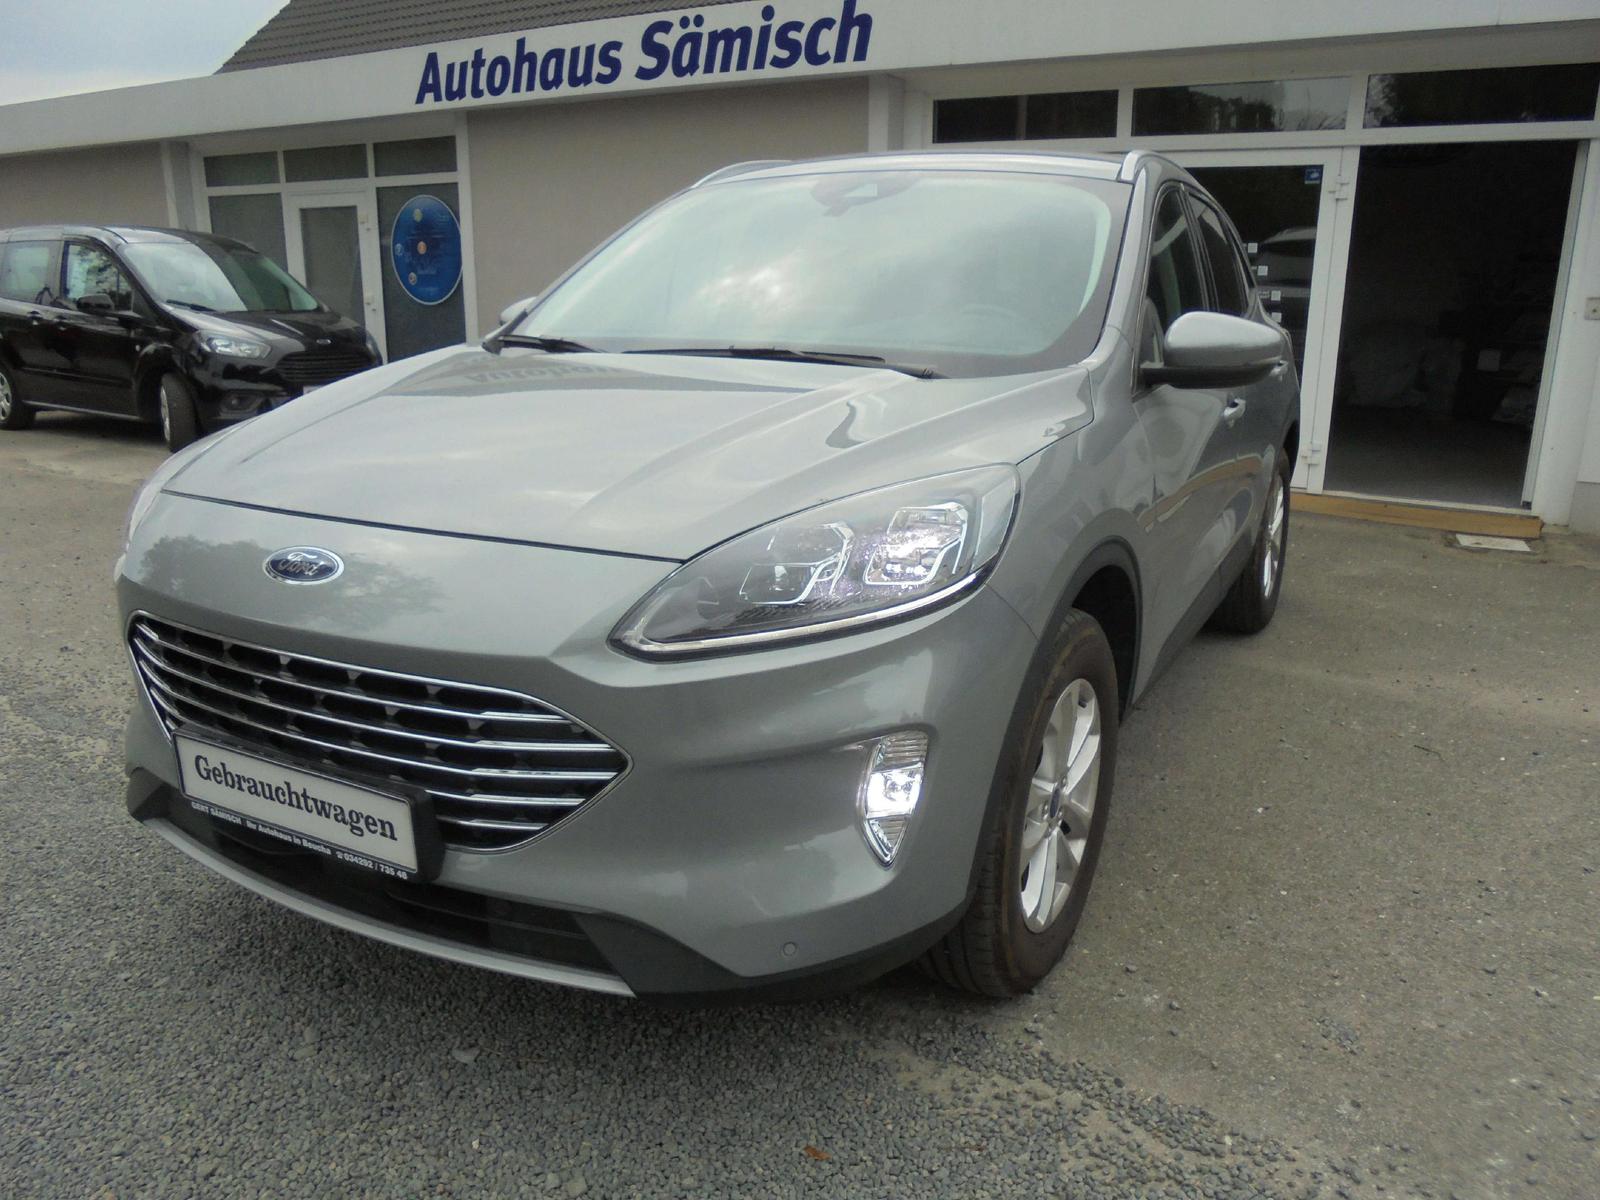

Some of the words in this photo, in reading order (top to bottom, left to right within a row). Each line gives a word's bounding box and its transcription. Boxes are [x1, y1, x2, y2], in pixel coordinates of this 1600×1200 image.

[415, 37, 623, 104] Autohaus
[634, 0, 873, 81] Sämisch
[279, 552, 325, 576] Ford
[194, 754, 398, 841] Gebrauchtwagen
